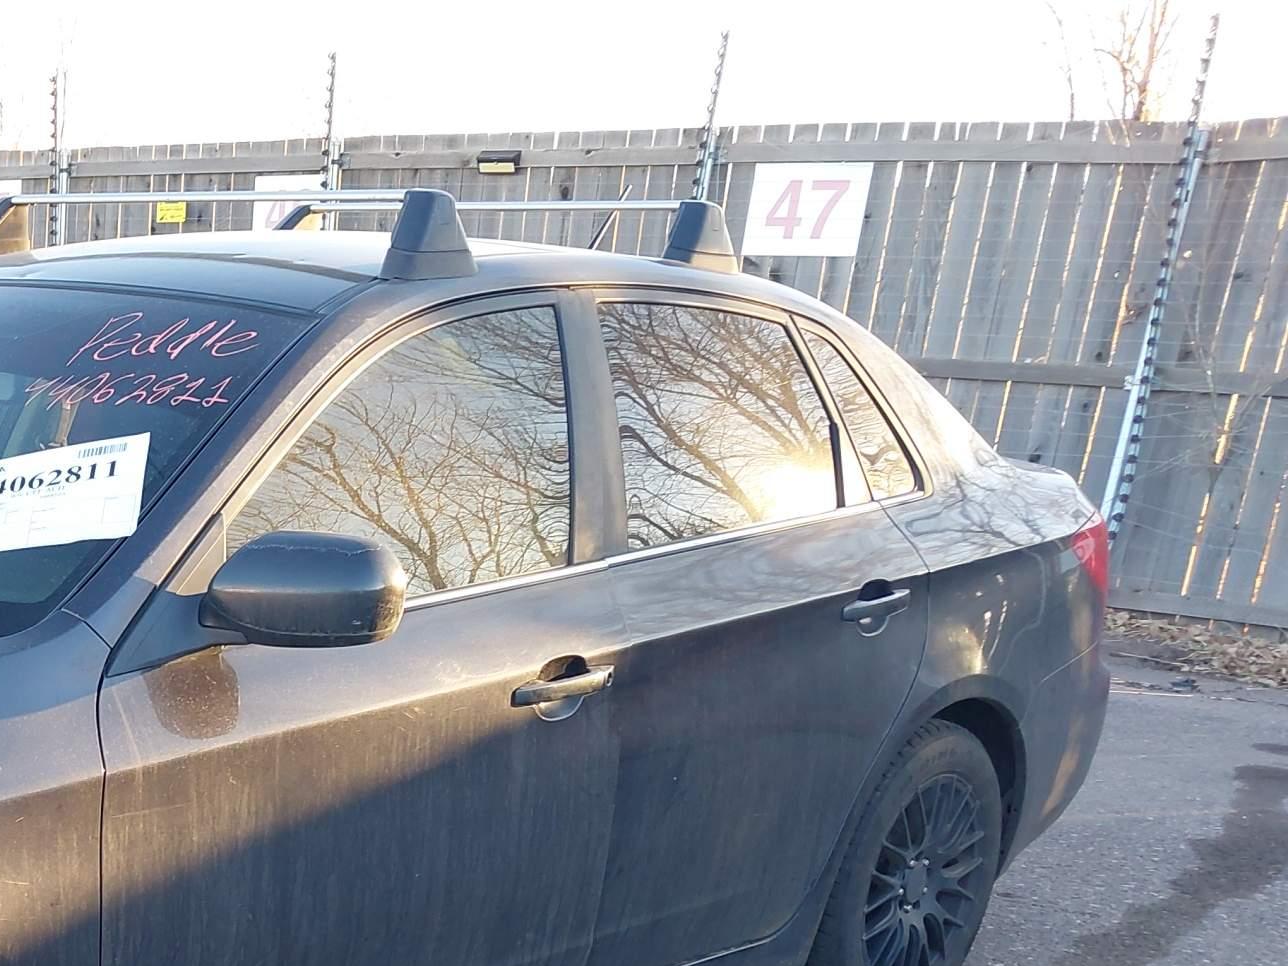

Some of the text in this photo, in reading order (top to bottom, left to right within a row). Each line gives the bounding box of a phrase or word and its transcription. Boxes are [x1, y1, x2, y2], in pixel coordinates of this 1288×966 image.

[765, 179, 851, 240] 47
[65, 311, 260, 368] Peddle
[24, 371, 229, 412] 44062811
